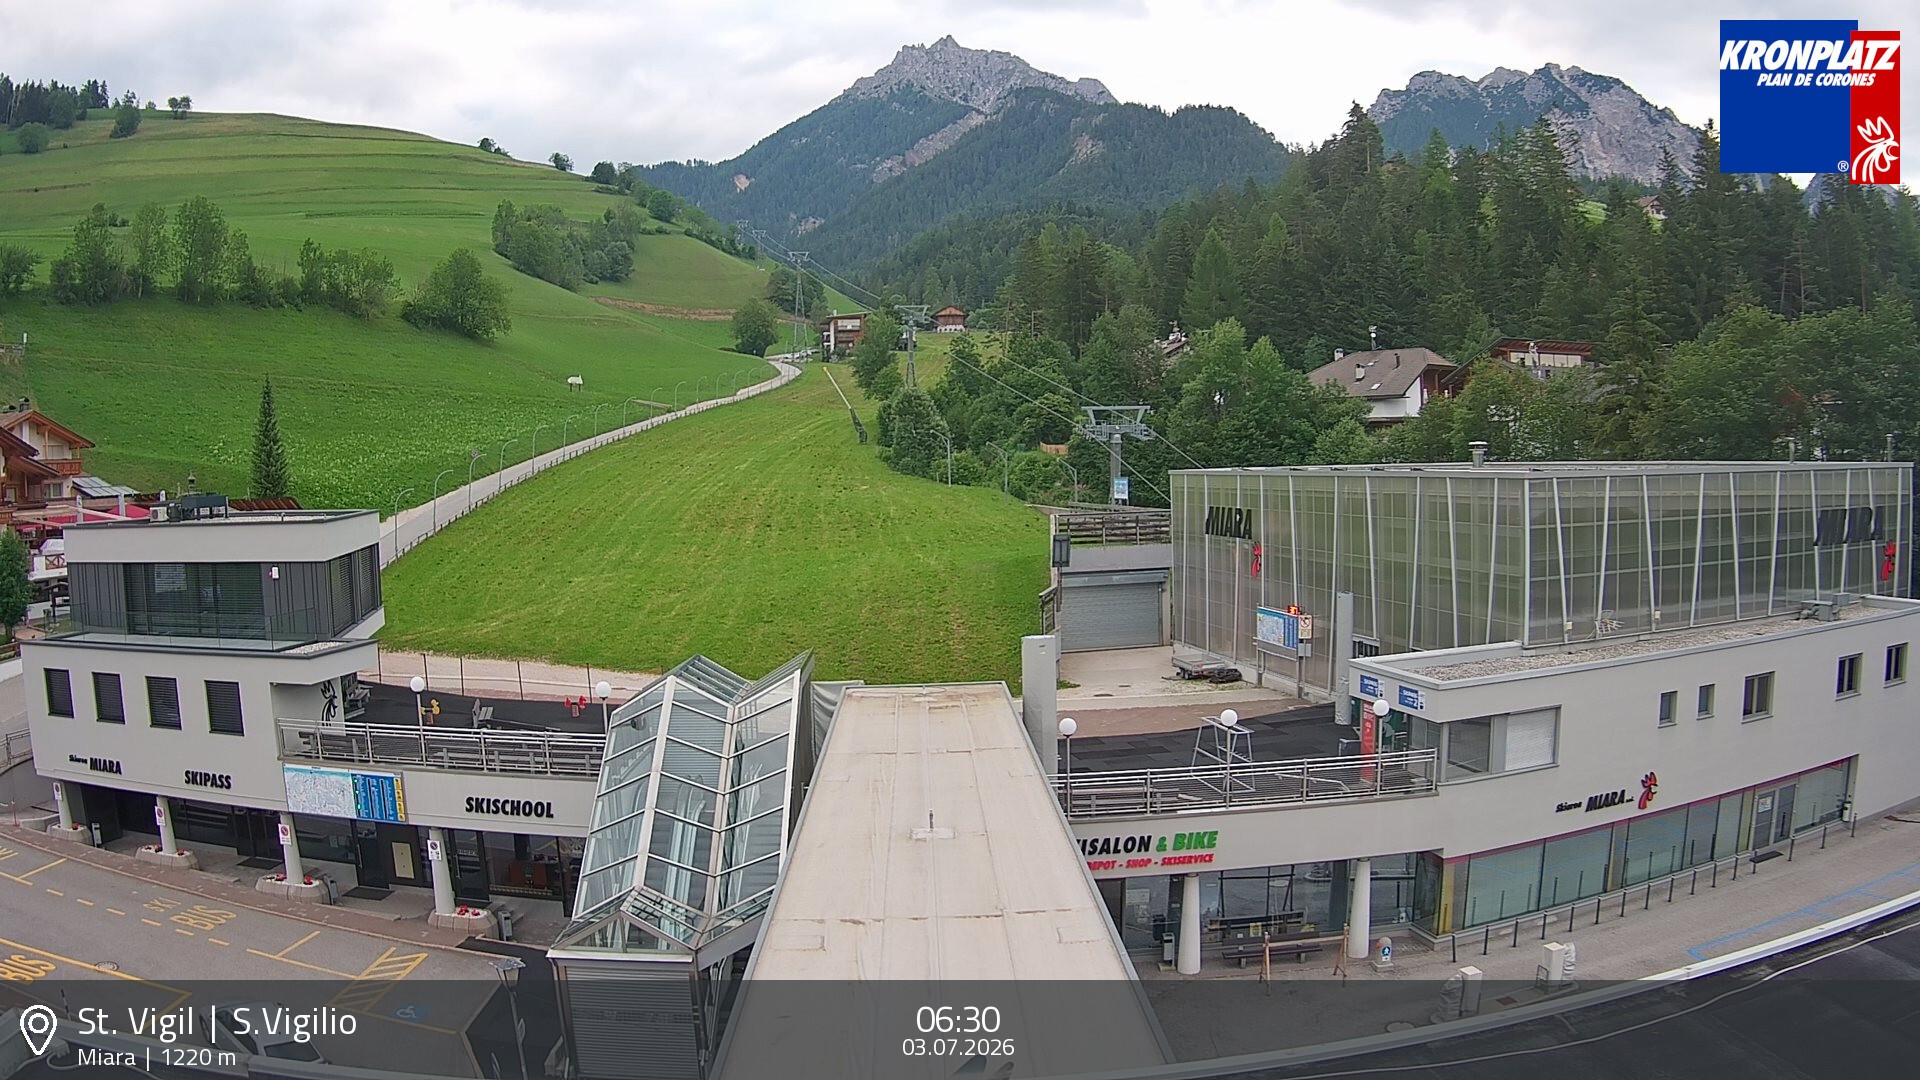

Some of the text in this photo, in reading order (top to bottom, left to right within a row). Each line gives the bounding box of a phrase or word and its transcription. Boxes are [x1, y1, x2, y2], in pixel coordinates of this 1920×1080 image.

[1205, 506, 1253, 540] MIARA
[90, 757, 122, 775] MIARA
[184, 770, 232, 789] SKIPASS
[465, 797, 554, 818] SKISCHOOL
[1585, 789, 1626, 812] MIARA
[1076, 831, 1219, 856] ISALON & BIKE
[1126, 858, 1152, 868] SHOP
[1161, 854, 1214, 866] SKISERVICE
[170, 905, 237, 930] BUS
